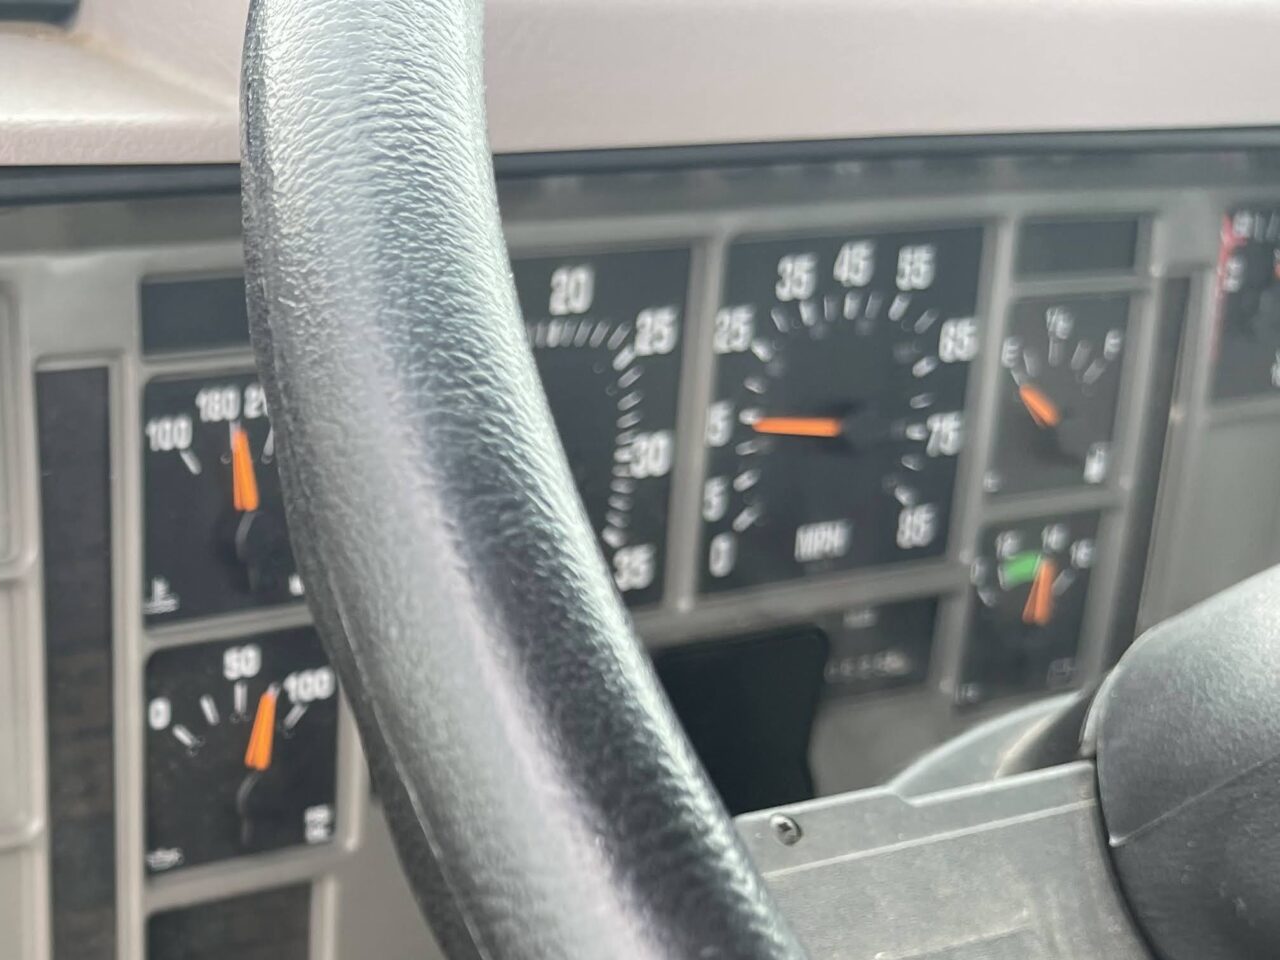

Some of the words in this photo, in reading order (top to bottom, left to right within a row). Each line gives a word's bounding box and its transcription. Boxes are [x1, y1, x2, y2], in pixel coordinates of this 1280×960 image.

[776, 253, 816, 301] 35
[834, 240, 875, 287] 45
[897, 245, 936, 291] 55
[549, 264, 594, 316] 20
[635, 306, 679, 356] 25
[713, 304, 754, 354] 25
[939, 316, 980, 363] 65
[195, 385, 241, 422] 180
[145, 416, 193, 451] 100
[629, 430, 673, 479] 30
[926, 410, 967, 457] 75
[703, 475, 728, 522] 5
[709, 532, 737, 577] 0
[794, 520, 850, 562] MPH
[612, 544, 656, 591] 35
[223, 644, 262, 681] 50
[283, 666, 336, 703] 100
[148, 697, 172, 731] 0
